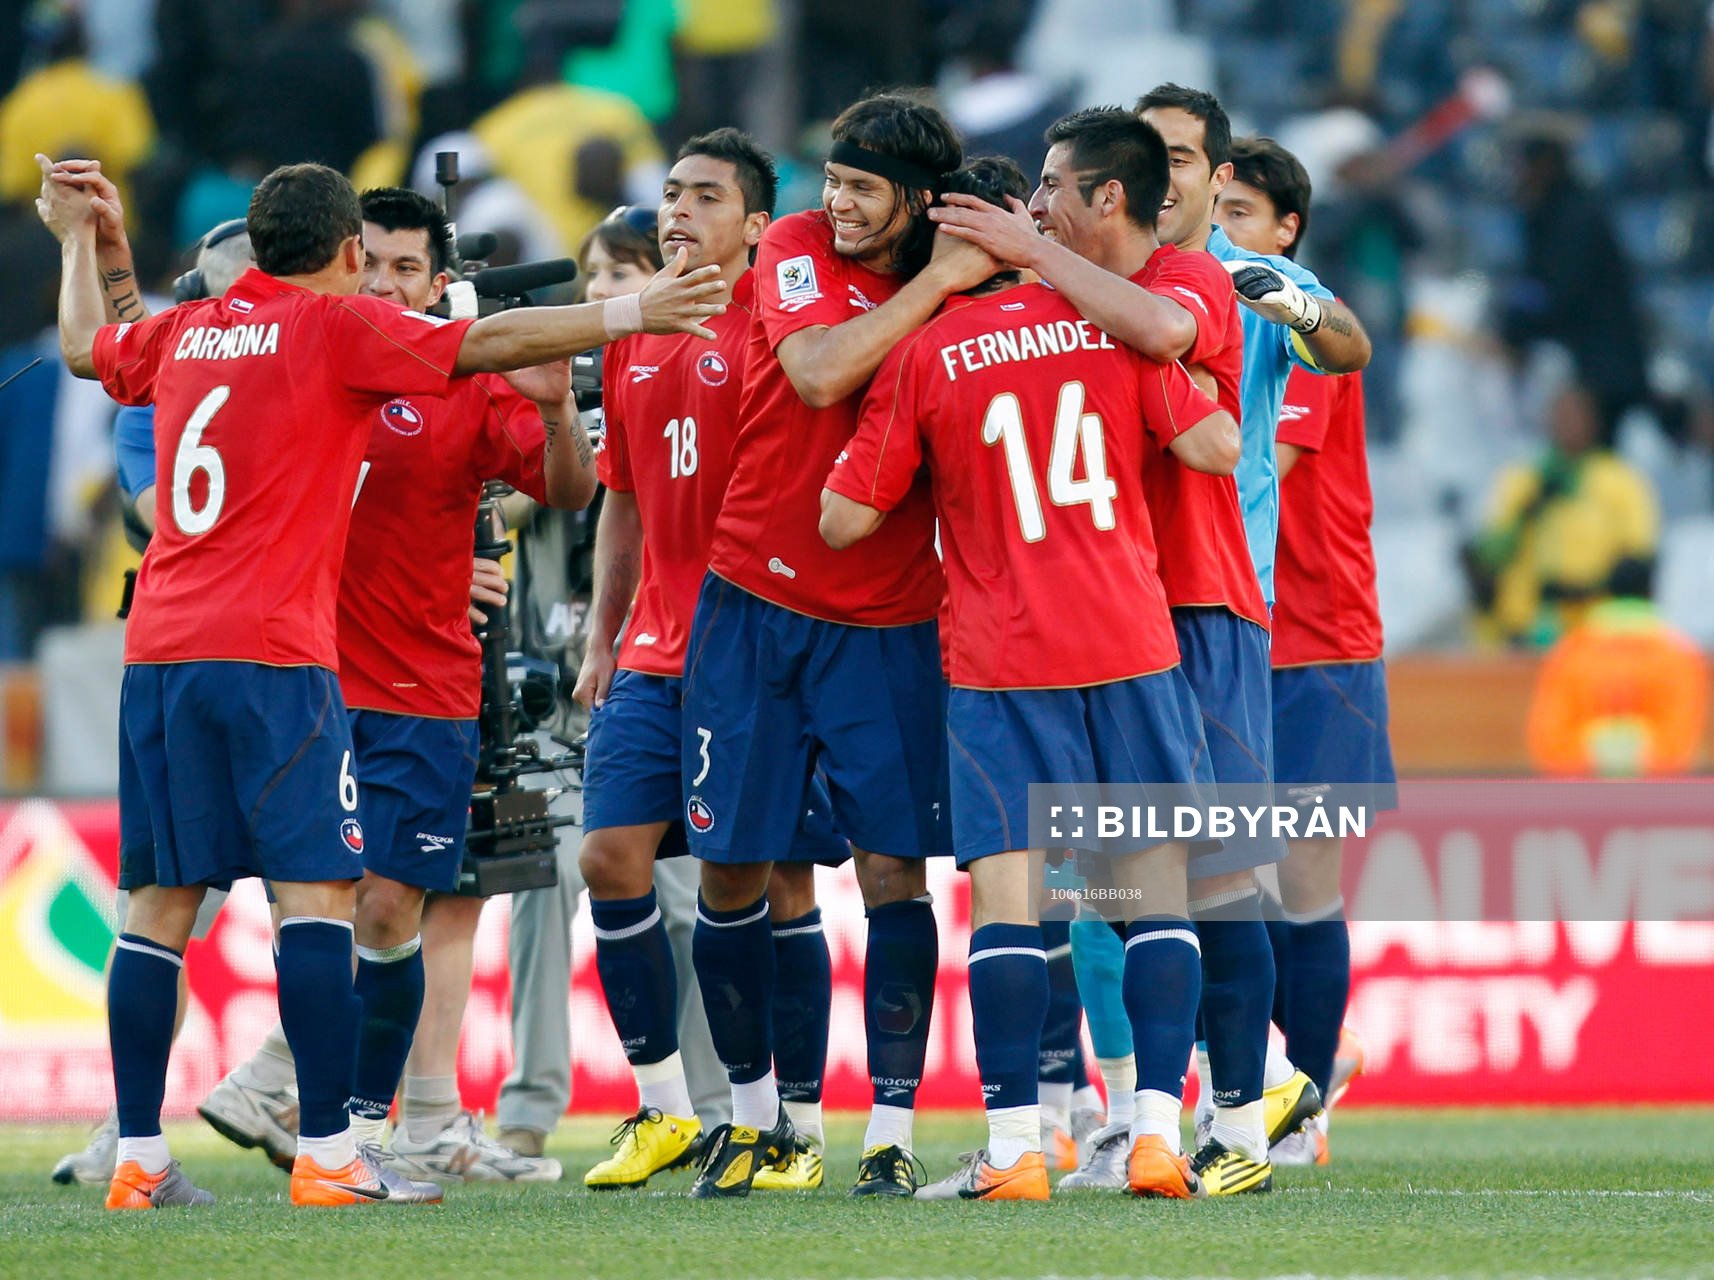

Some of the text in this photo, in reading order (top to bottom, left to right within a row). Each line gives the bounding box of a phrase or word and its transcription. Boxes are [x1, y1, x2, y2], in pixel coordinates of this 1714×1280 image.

[174, 322, 280, 360] CARMONA
[171, 384, 230, 536] 6
[663, 416, 699, 480] 18
[981, 380, 1118, 543] 14
[339, 749, 359, 812] 6
[1343, 974, 1600, 1075] FETY
[871, 1076, 920, 1087] BROOKS
[981, 1084, 1002, 1092] OKS
